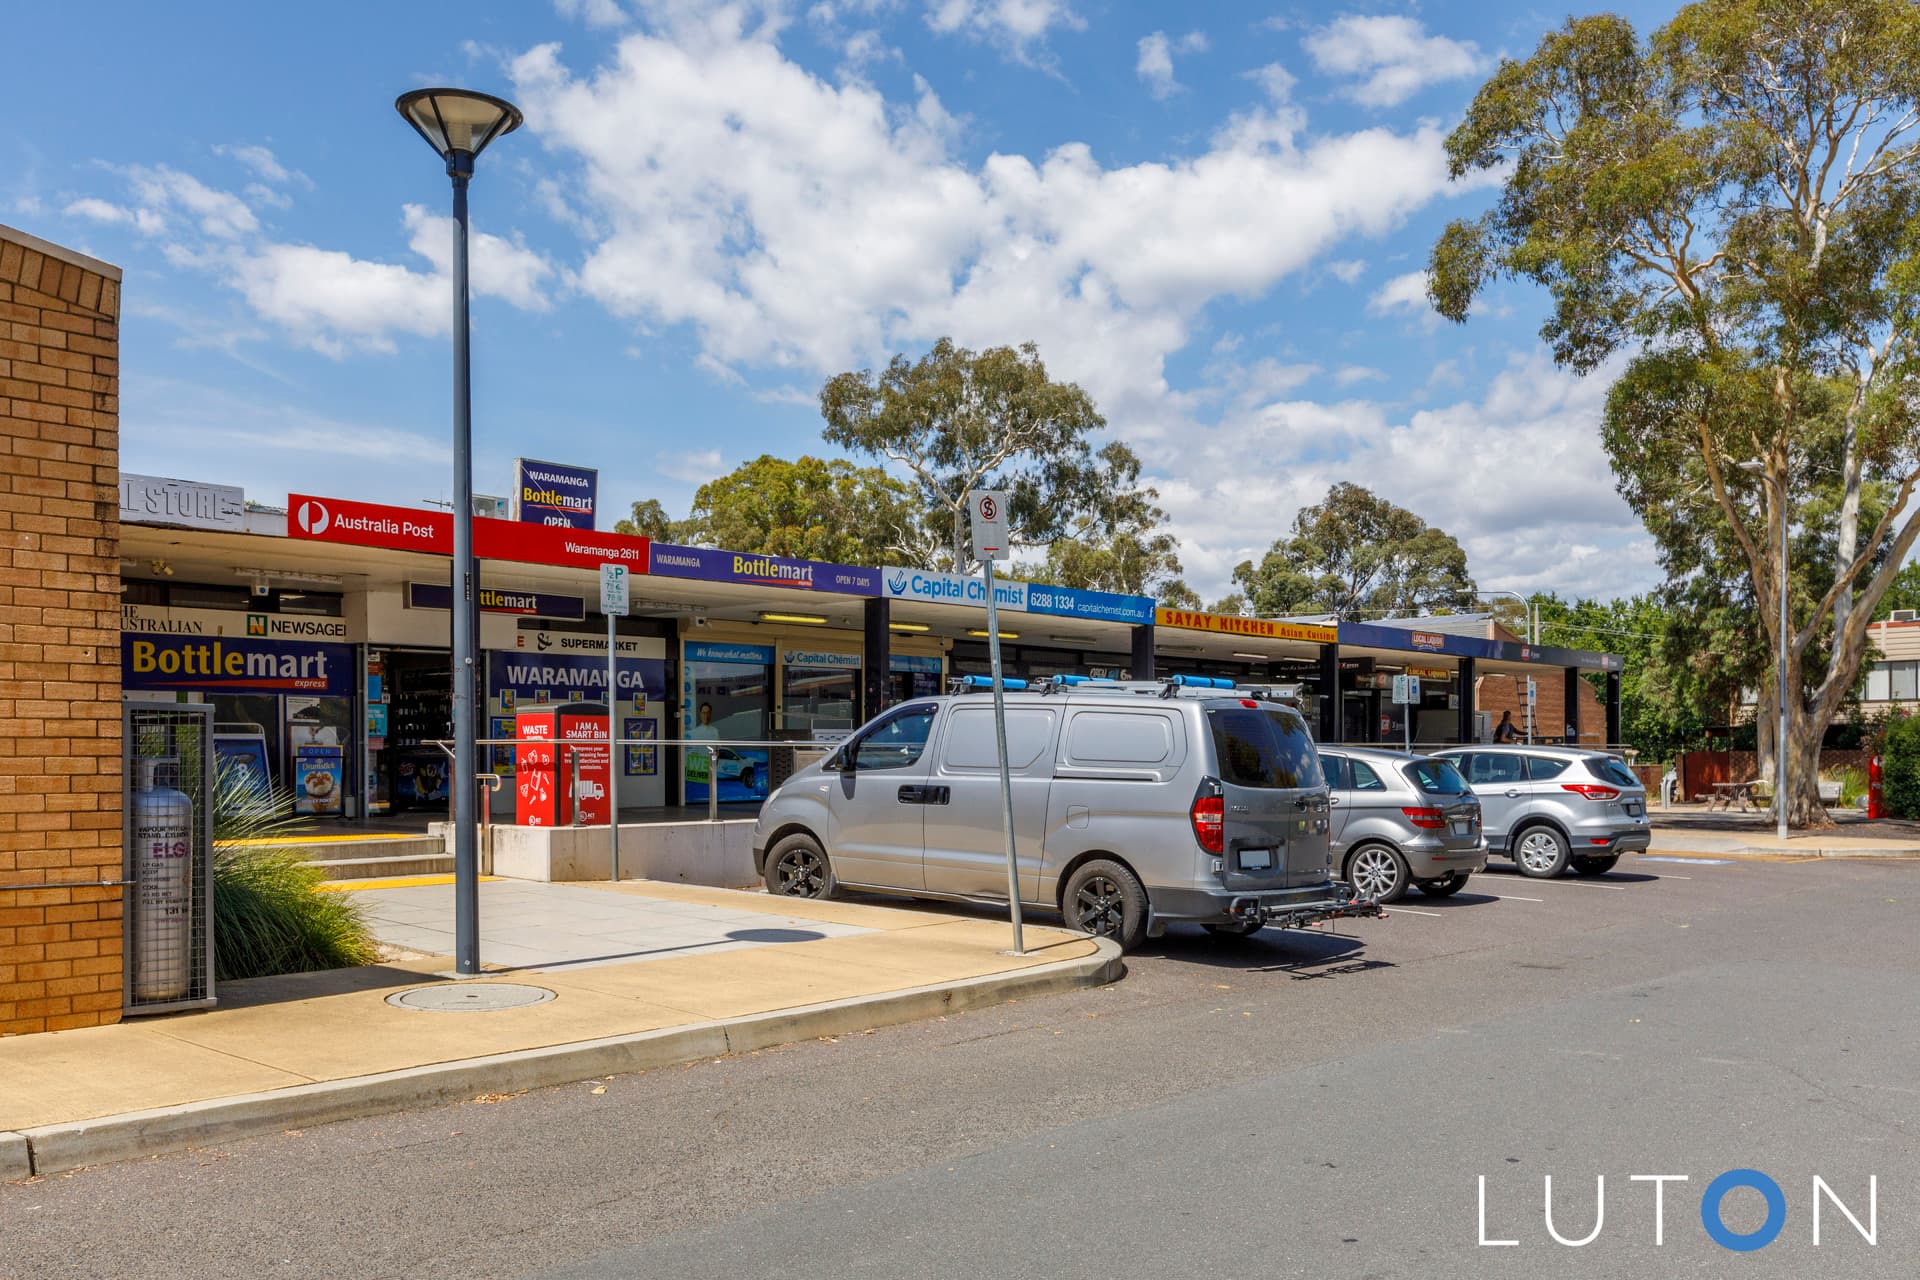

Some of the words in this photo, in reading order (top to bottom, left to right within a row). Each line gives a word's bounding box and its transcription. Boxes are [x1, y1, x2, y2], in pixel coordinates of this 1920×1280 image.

[529, 470, 589, 488] WARAMANGA
[523, 487, 593, 510] Bottlemart
[334, 513, 399, 535] Australia
[402, 521, 434, 539] Post
[565, 541, 619, 558] Waramanga
[620, 547, 639, 560] 2611
[656, 553, 701, 569] WARAMANGA
[733, 556, 813, 581] Bottlemart
[835, 575, 851, 585] OPEN
[852, 576, 856, 585] 7
[856, 577, 870, 588] DAYS
[911, 575, 964, 599] Capital
[967, 581, 1023, 605] Chmist
[480, 590, 537, 609] ttlemart
[1030, 592, 1052, 607] 6288
[1054, 594, 1074, 610] 1334
[1077, 602, 1145, 618] capitalchemist.com.au
[120, 617, 203, 633] USTRALIAN
[271, 619, 346, 637] NEWSAGE
[1165, 611, 1212, 628] SATAY
[1220, 617, 1274, 635] KITCHEN
[560, 638, 638, 652] SUPERMKET
[133, 641, 328, 679] Bottlemart
[796, 652, 826, 665] Capital
[827, 654, 861, 666] Chemist
[294, 680, 326, 689] express
[522, 724, 548, 735] WASTE
[566, 730, 592, 739] SMART
[593, 731, 608, 740] BIN
[580, 722, 592, 731] AM
[593, 722, 599, 731] A
